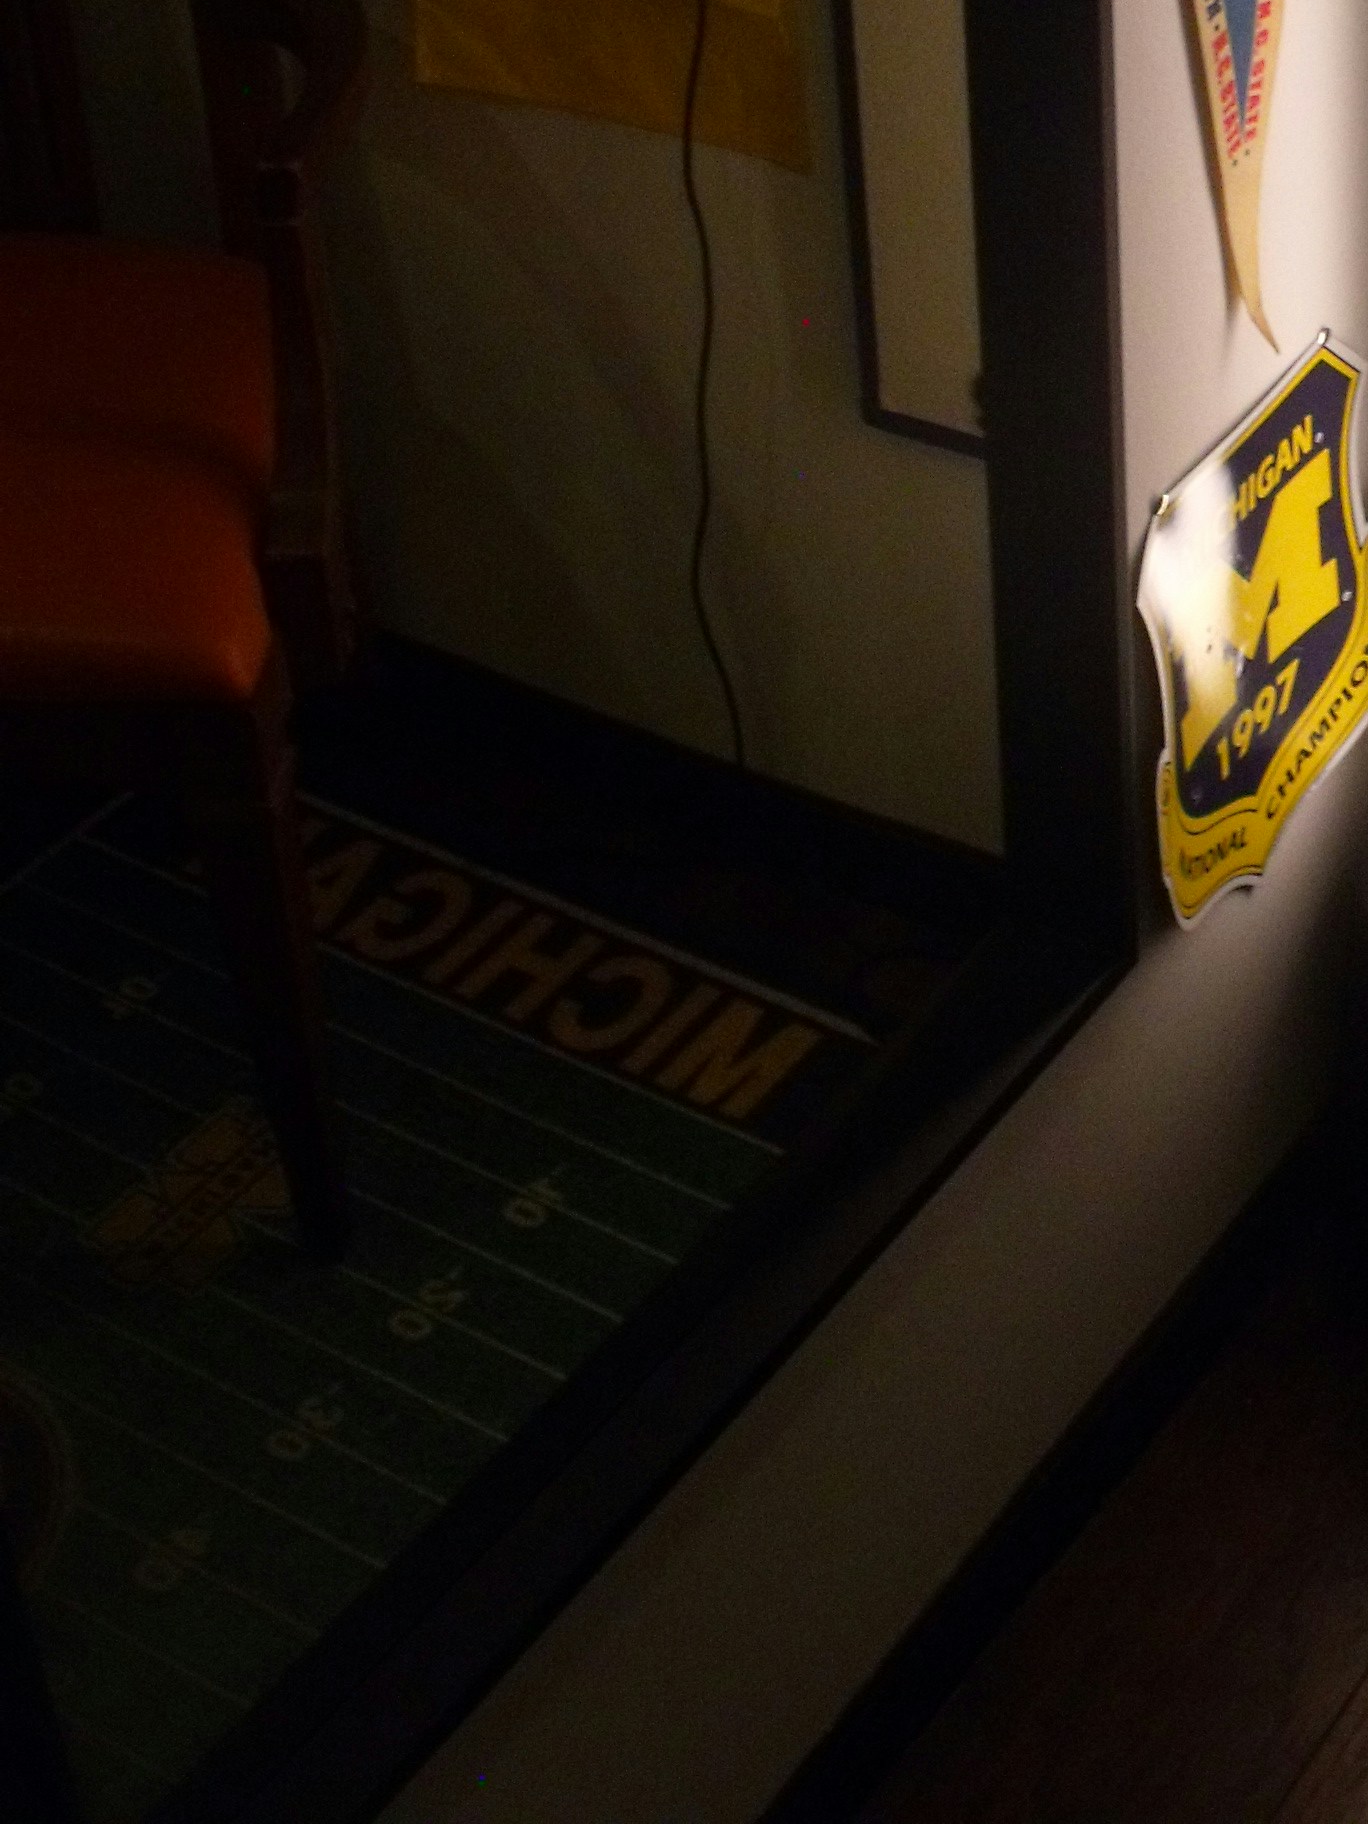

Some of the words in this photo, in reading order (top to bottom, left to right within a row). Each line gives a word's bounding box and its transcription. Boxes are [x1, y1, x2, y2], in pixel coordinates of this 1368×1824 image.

[1244, 59, 1266, 143] STATE
[1226, 414, 1313, 526] HIGAN
[1216, 657, 1300, 781] 1997
